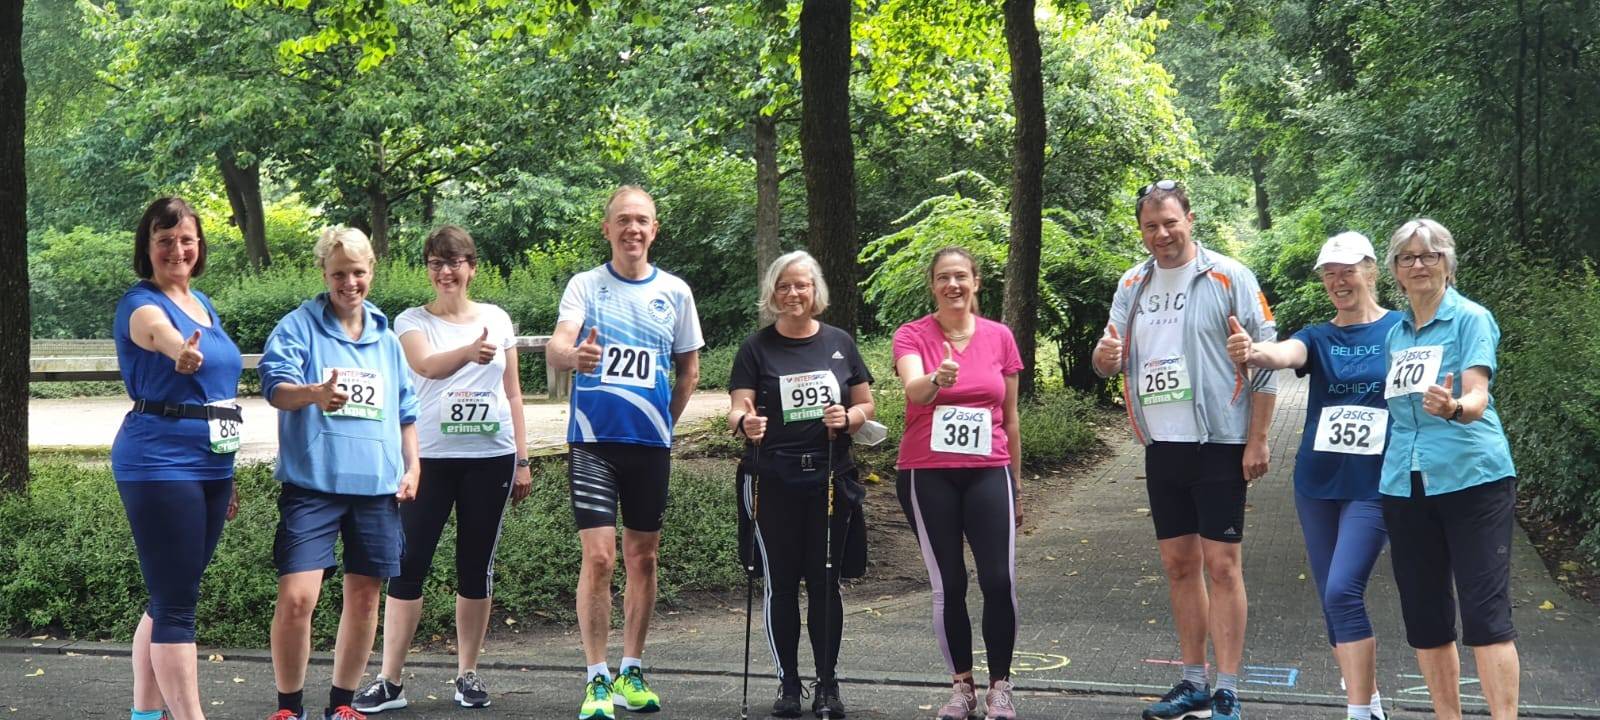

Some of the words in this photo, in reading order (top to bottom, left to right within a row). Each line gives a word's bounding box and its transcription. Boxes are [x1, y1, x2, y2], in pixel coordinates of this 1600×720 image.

[1330, 344, 1381, 356] BELIEVE
[606, 347, 650, 380] 220
[1145, 370, 1180, 393] 265
[1393, 363, 1425, 389] 470
[791, 385, 832, 408] 993
[1328, 381, 1381, 394] ACHIEVE
[451, 403, 490, 422] 877
[790, 408, 824, 420] erima
[956, 411, 985, 423] asics
[1343, 410, 1376, 422] asics
[446, 424, 481, 433] erima
[944, 423, 980, 448] 381
[1328, 422, 1371, 448] 352
